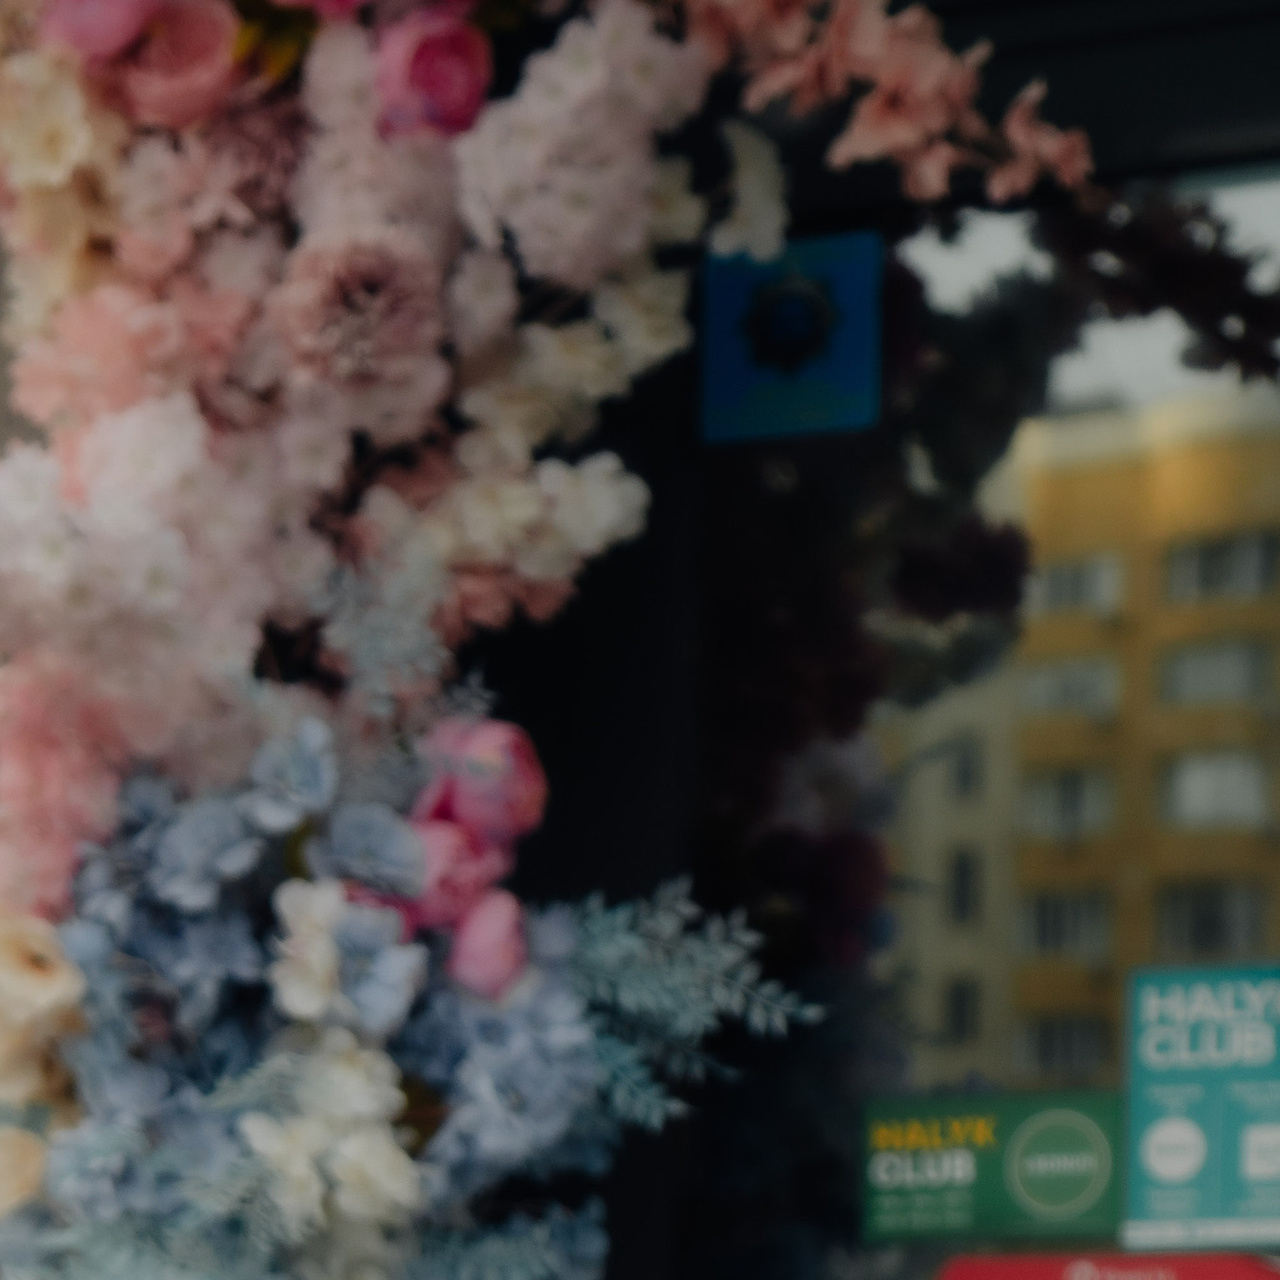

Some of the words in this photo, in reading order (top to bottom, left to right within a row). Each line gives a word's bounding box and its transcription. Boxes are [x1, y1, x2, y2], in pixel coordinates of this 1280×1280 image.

[1140, 981, 1280, 1022] HALY
[1140, 1022, 1273, 1068] CLUB
[871, 1117, 996, 1150] HALYK
[869, 1151, 976, 1188] CLUB
